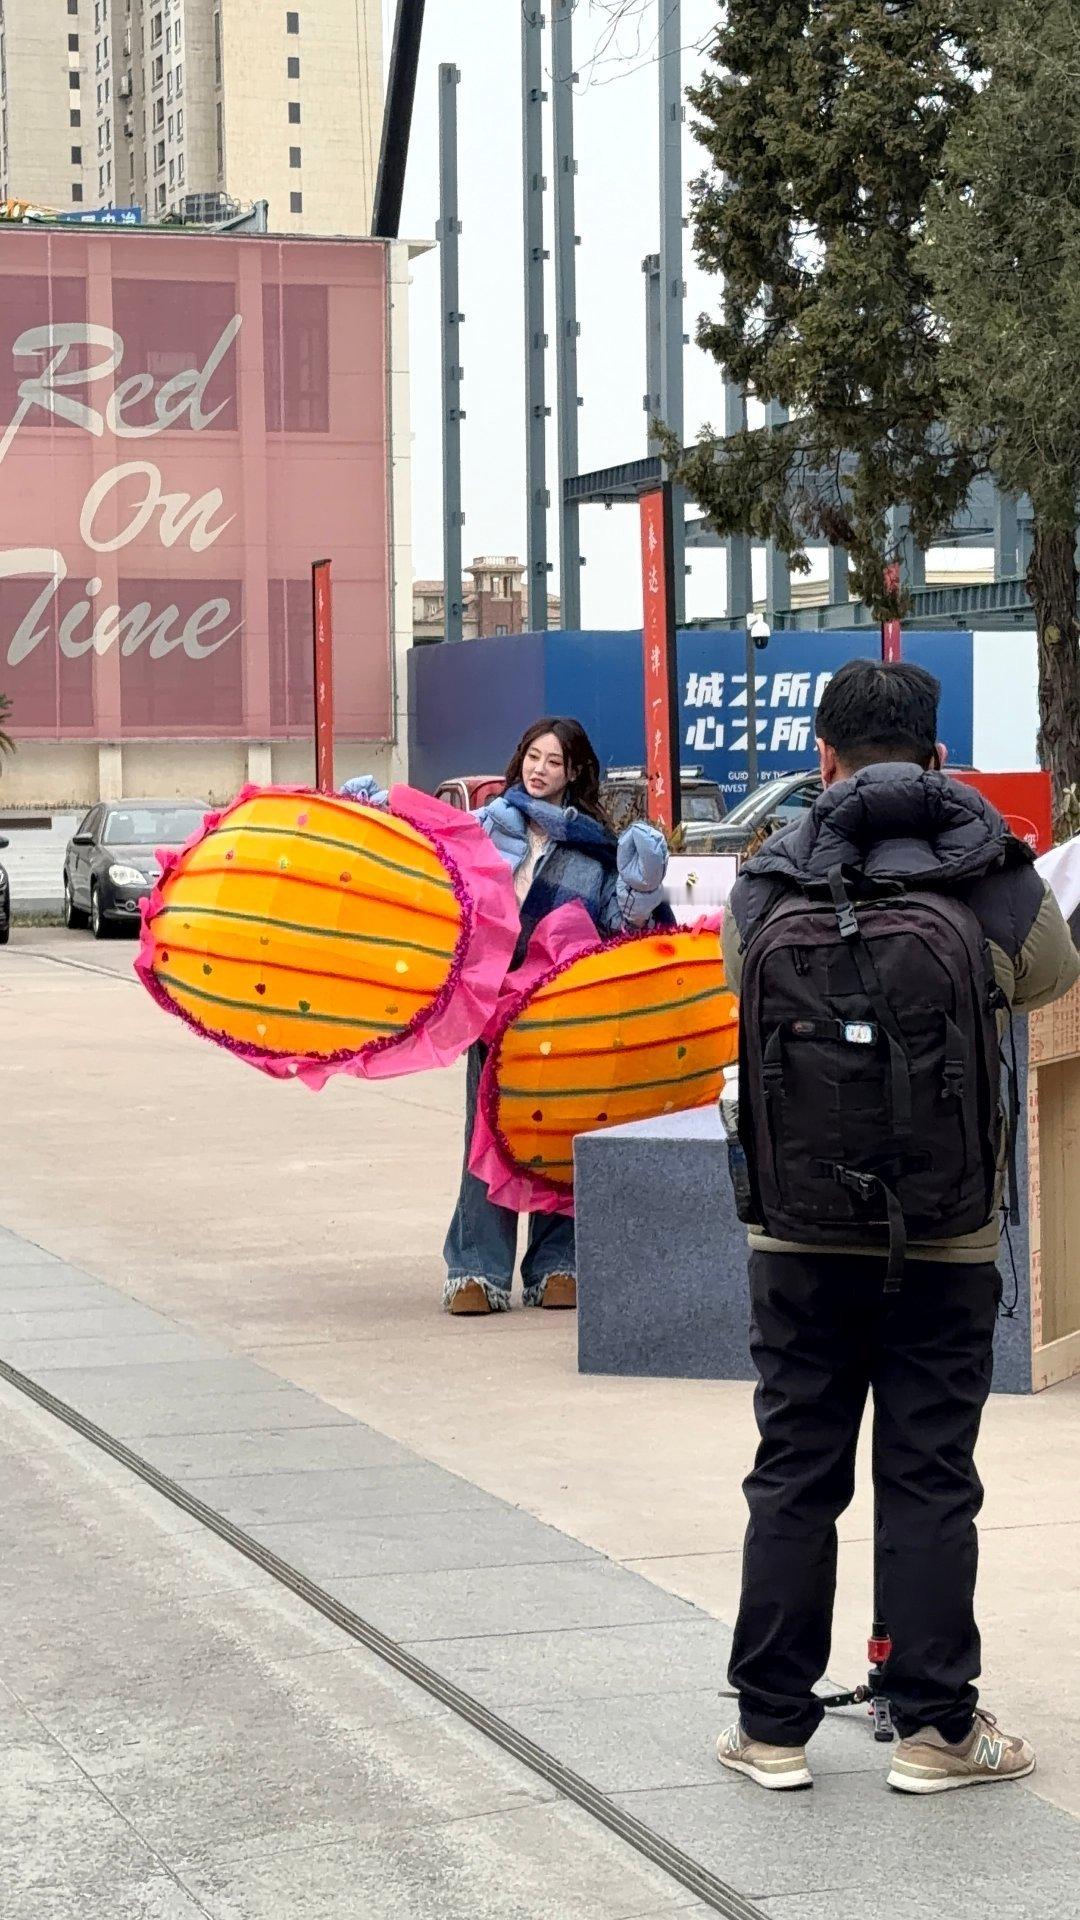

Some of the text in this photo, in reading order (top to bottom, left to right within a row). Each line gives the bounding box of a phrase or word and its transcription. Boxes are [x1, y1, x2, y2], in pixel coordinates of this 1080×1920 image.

[0, 313, 243, 464] Red
[80, 461, 237, 552] On
[0, 547, 246, 667] Time
[685, 716, 818, 751] 心之所
[973, 1733, 1003, 1770] N
